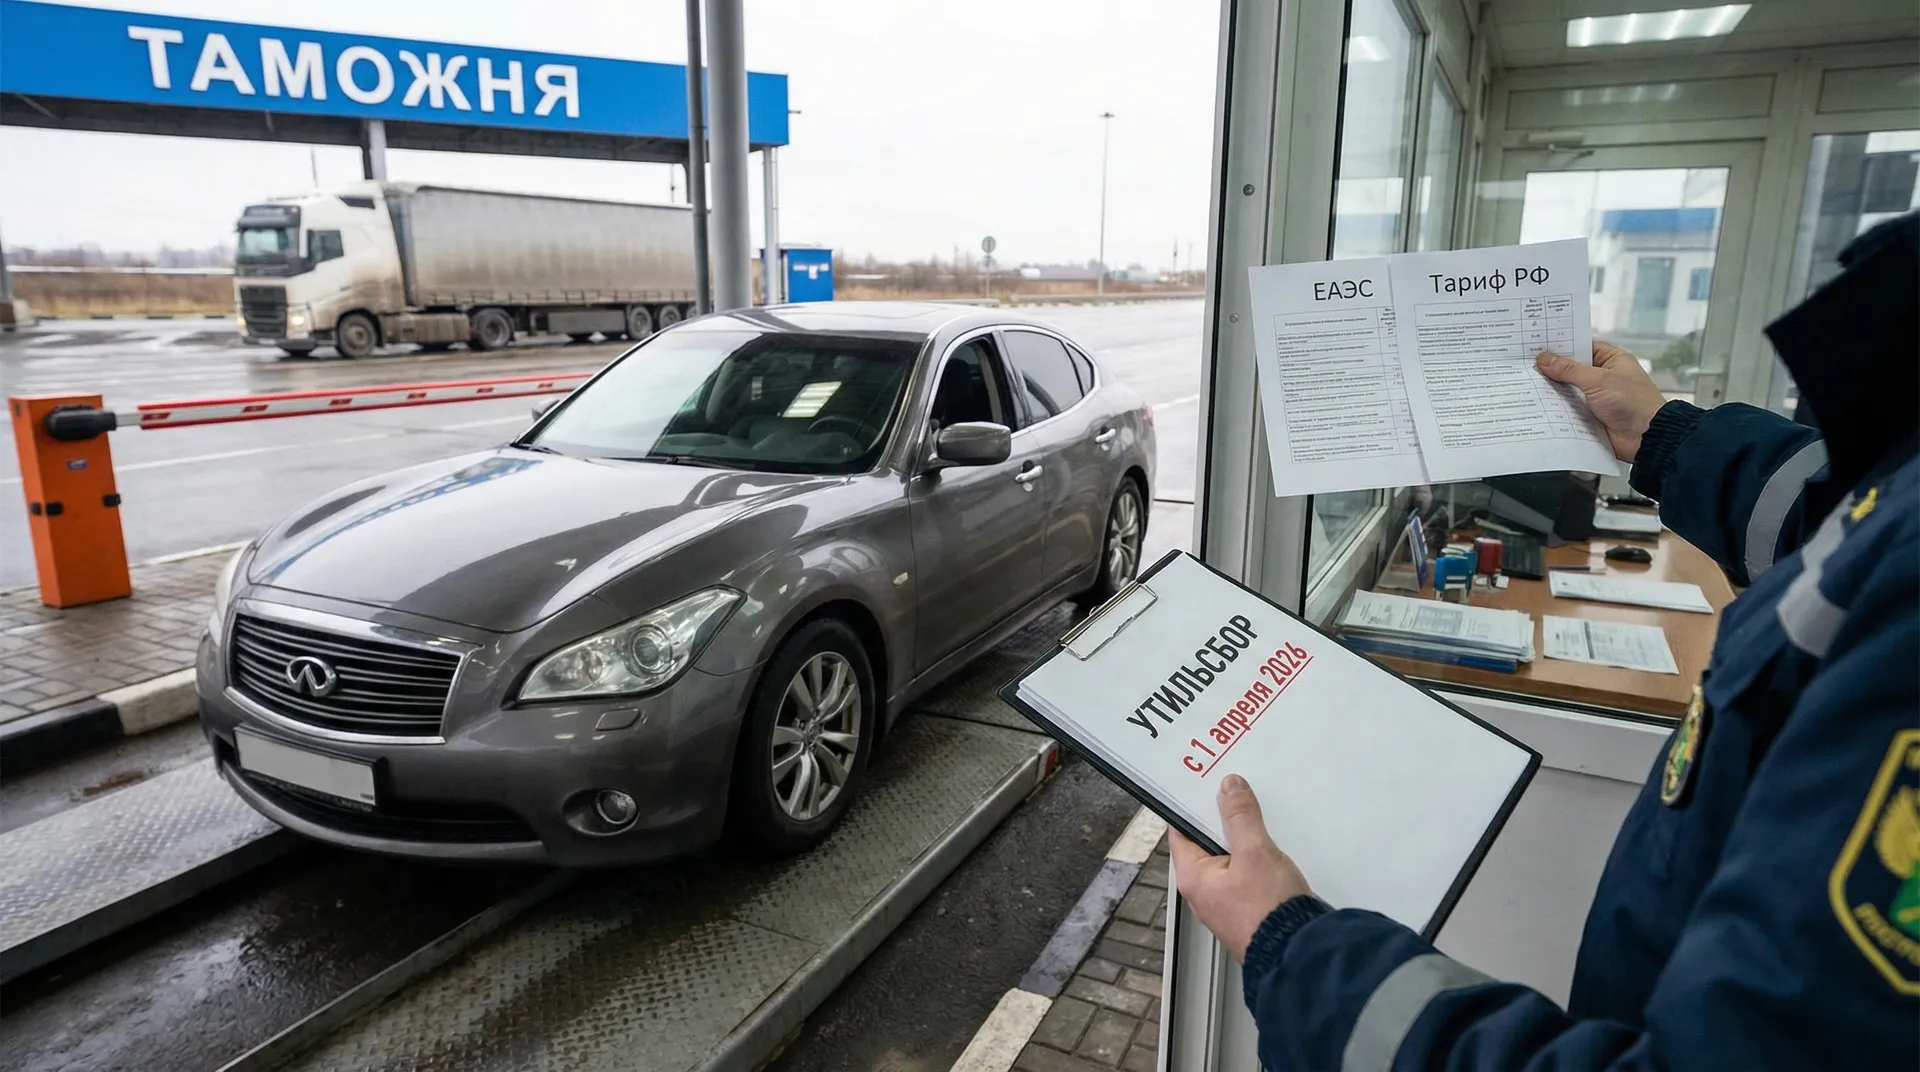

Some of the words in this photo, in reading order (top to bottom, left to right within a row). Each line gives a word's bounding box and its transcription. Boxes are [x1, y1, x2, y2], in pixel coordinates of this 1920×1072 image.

[127, 25, 580, 118] ТАМОЖНЯ
[1313, 279, 1374, 301] ЕАЭС
[1429, 269, 1506, 297] Тариф
[1515, 265, 1550, 287] РФ
[1126, 614, 1258, 739] УТИЛЬСБОР
[1259, 641, 1307, 686] 2026
[1209, 681, 1274, 744] апреля
[1183, 755, 1203, 772] с
[1190, 738, 1216, 757] 1
